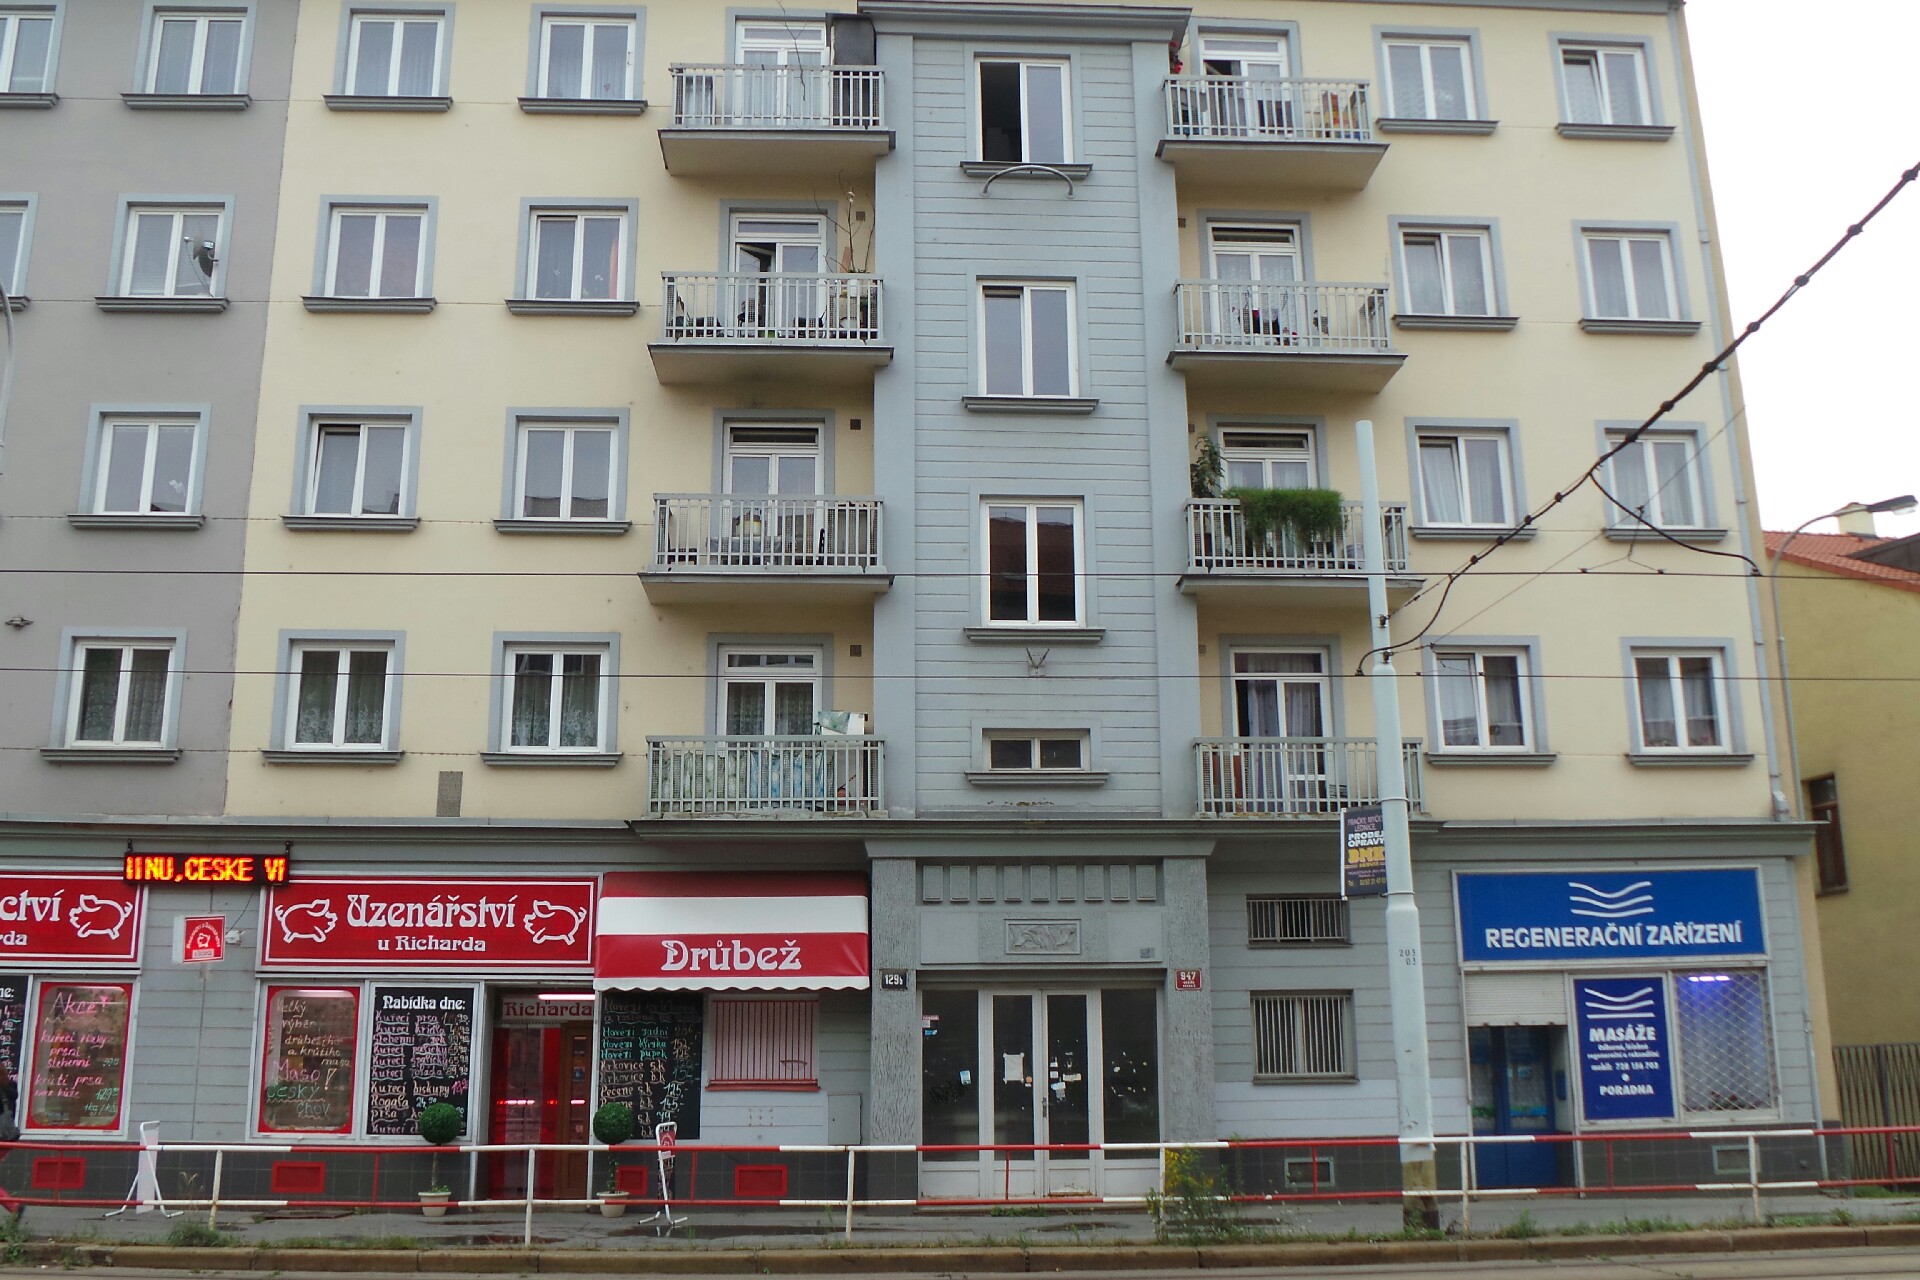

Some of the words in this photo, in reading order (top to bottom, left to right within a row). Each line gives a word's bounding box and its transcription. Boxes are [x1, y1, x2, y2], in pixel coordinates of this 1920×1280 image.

[347, 894, 518, 928] Uzenářství
[1484, 922, 1644, 949] REGENERAČNÍ
[1645, 920, 1743, 946] ZAŘÍZENÍ
[377, 939, 389, 951] u
[395, 935, 487, 952] Richarda
[660, 939, 802, 971] Drůbež
[1180, 971, 1197, 981] 947
[382, 995, 437, 1010] Nabídka
[439, 996, 466, 1010] dne:
[503, 1000, 593, 1017] Richarda
[1589, 1023, 1657, 1042] MASÁŽE
[1599, 1083, 1655, 1096] PORADNA
